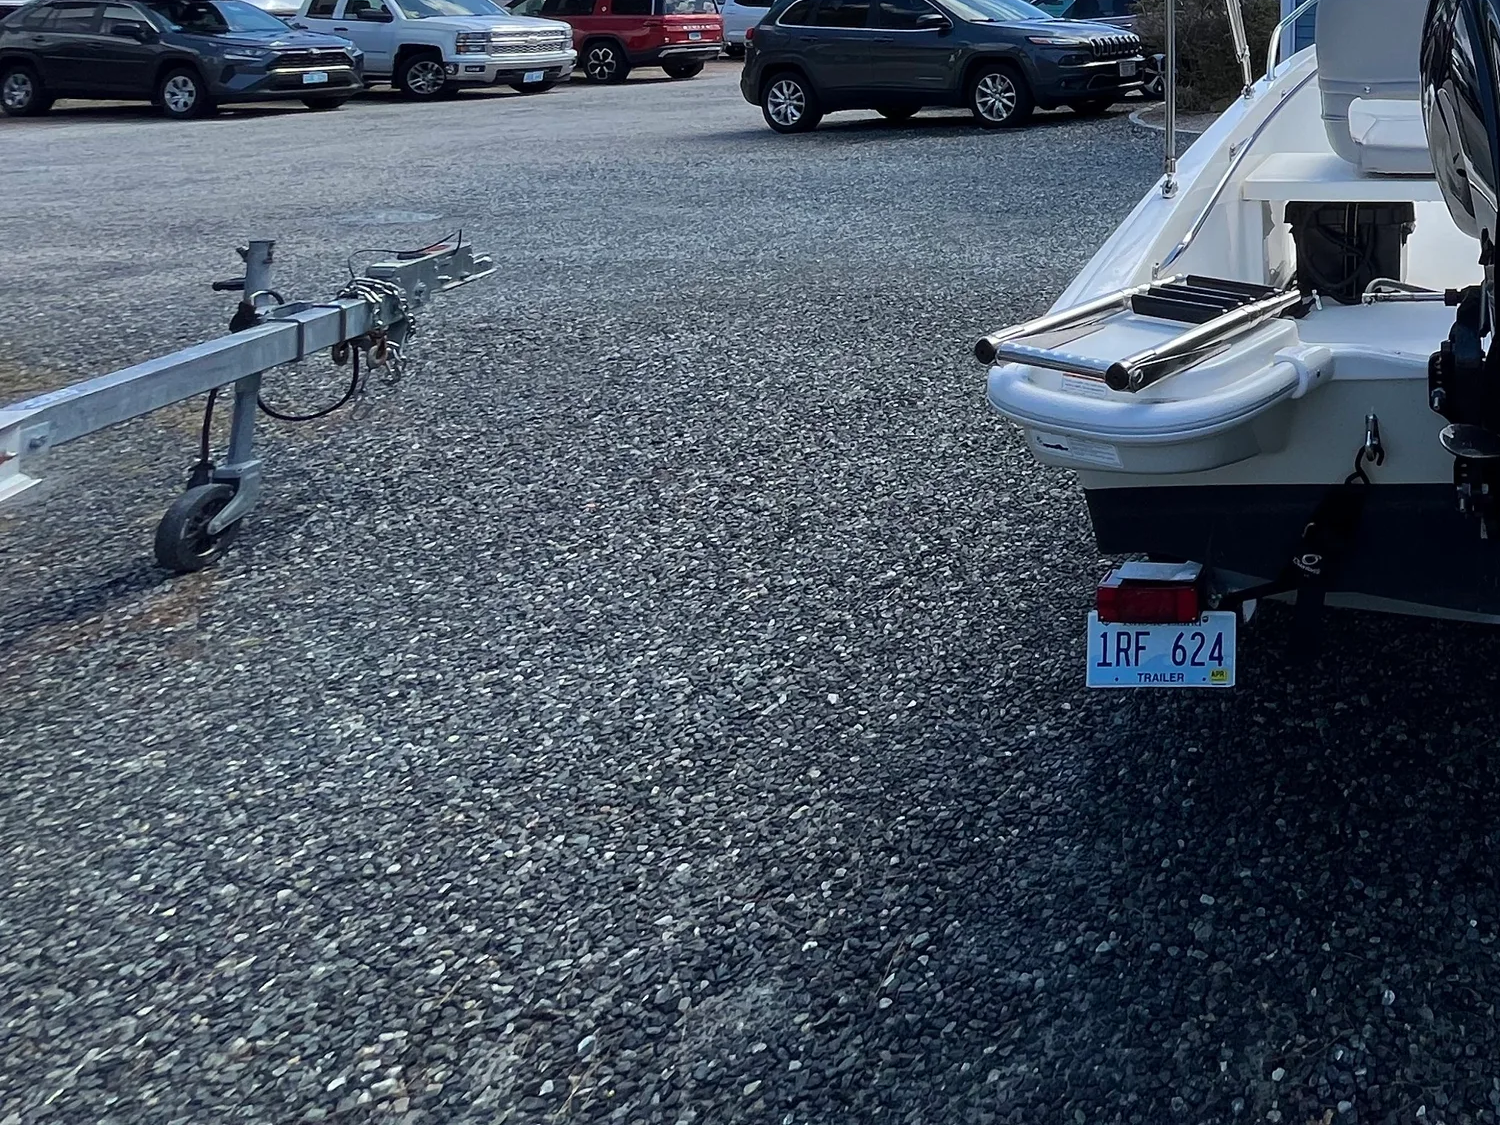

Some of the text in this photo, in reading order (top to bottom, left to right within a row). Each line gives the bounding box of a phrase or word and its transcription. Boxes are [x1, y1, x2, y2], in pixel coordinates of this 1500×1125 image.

[1097, 631, 1224, 667] 1RF 624
[1137, 672, 1185, 683] TRAILER
